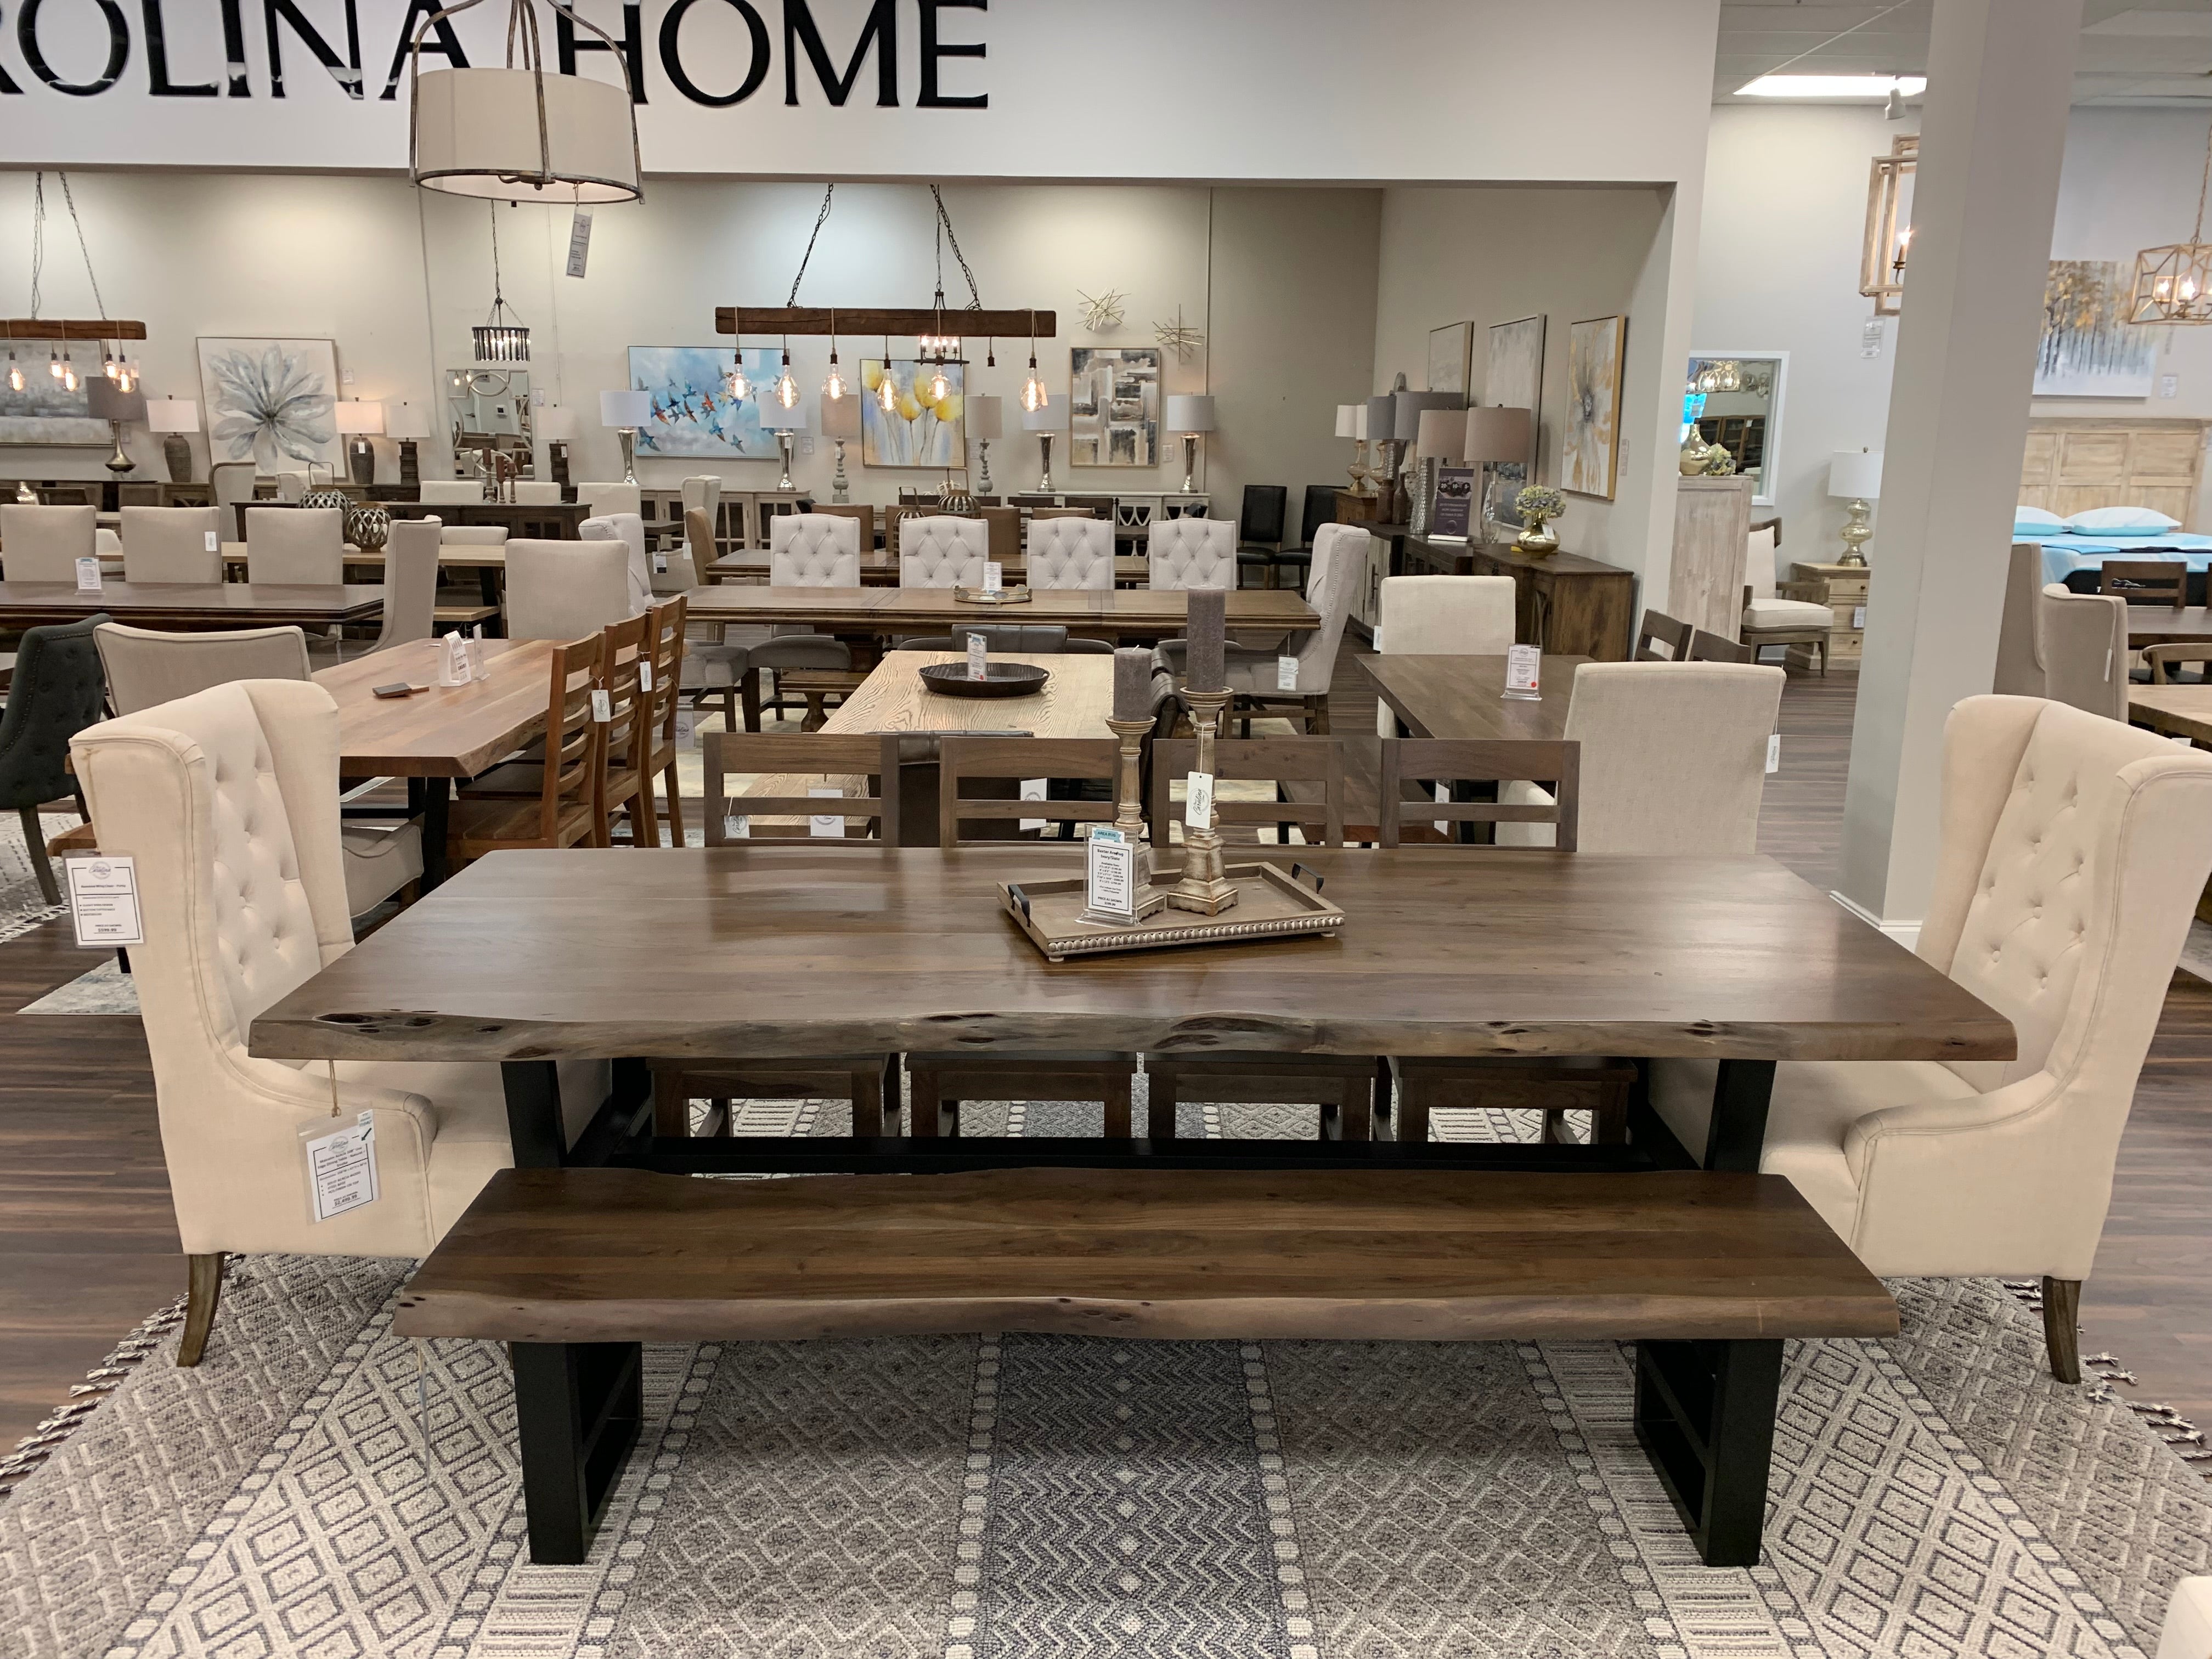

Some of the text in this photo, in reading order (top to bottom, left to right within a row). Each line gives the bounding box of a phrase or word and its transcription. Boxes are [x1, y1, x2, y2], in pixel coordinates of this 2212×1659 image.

[0, 0, 988, 108] OLINA HOME
[1193, 788, 1202, 815] Carolina
